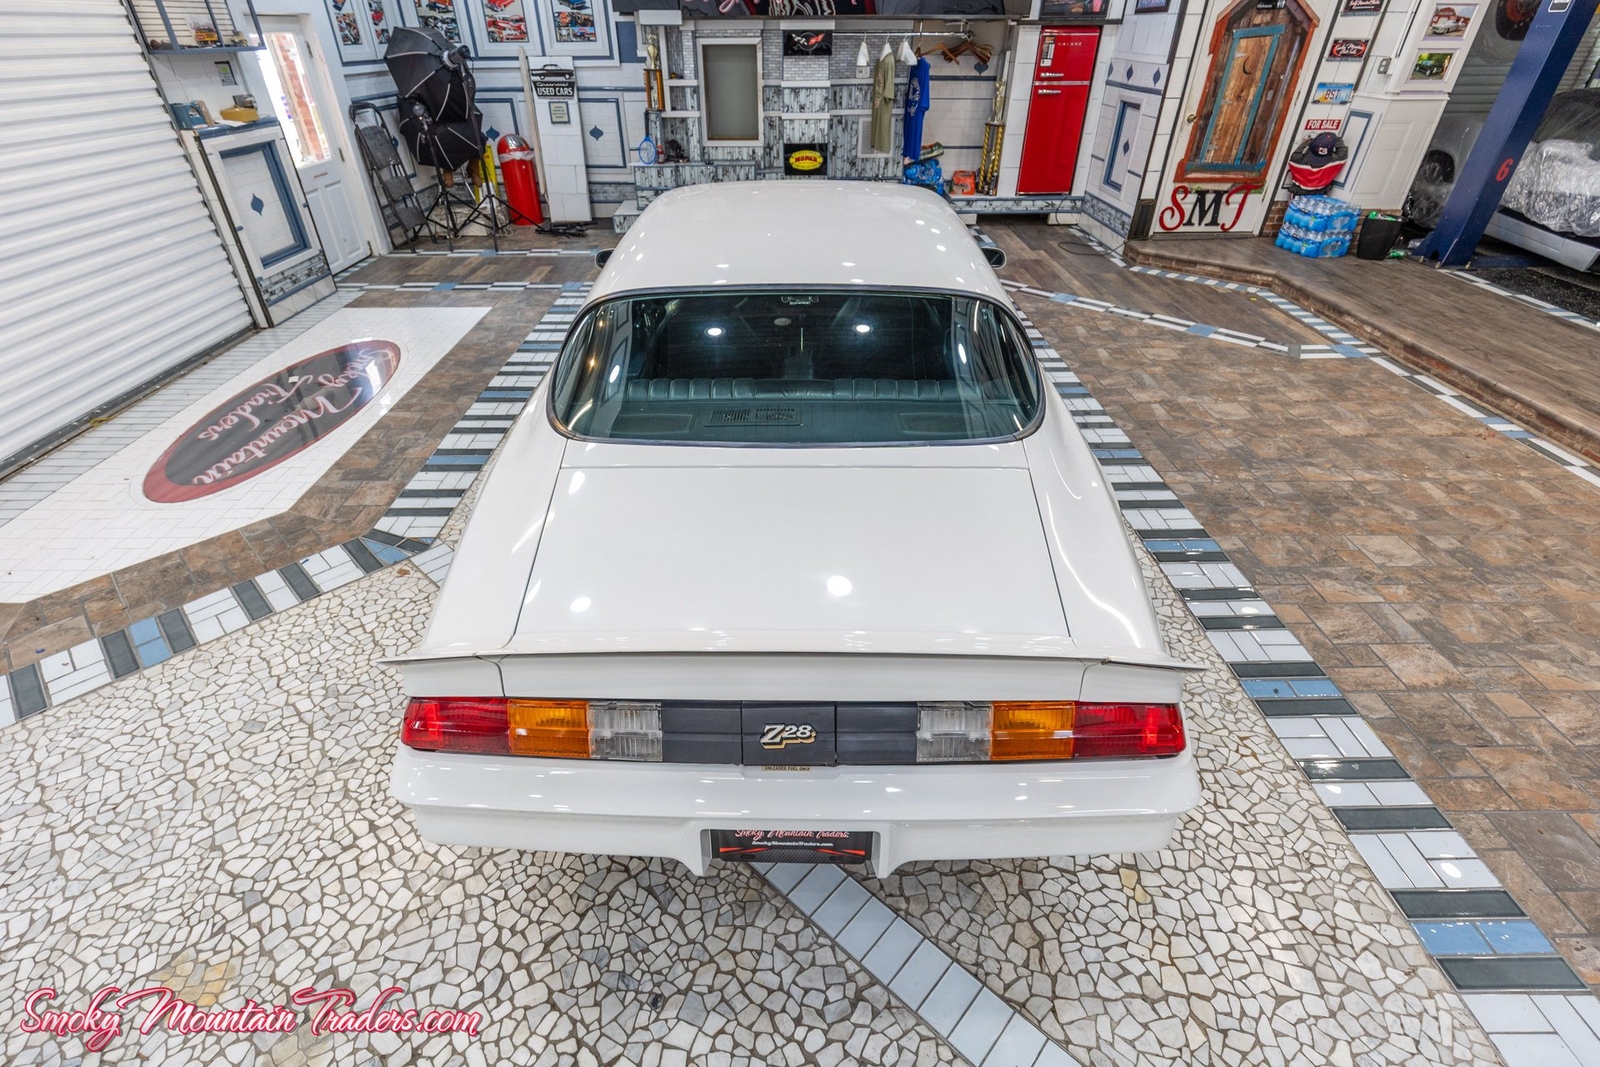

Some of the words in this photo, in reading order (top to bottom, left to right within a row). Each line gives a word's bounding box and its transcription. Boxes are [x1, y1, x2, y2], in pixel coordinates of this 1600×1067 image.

[537, 87, 555, 96] USED
[555, 87, 573, 96] CARS
[1307, 120, 1321, 129] FOR
[1321, 120, 1339, 129] SALE
[795, 155, 818, 163] MOPAR
[1496, 157, 1514, 182] 6
[1159, 184, 1261, 231] SMT
[197, 374, 314, 442] Traders
[192, 386, 363, 485] Mountain
[760, 723, 815, 747] Z28
